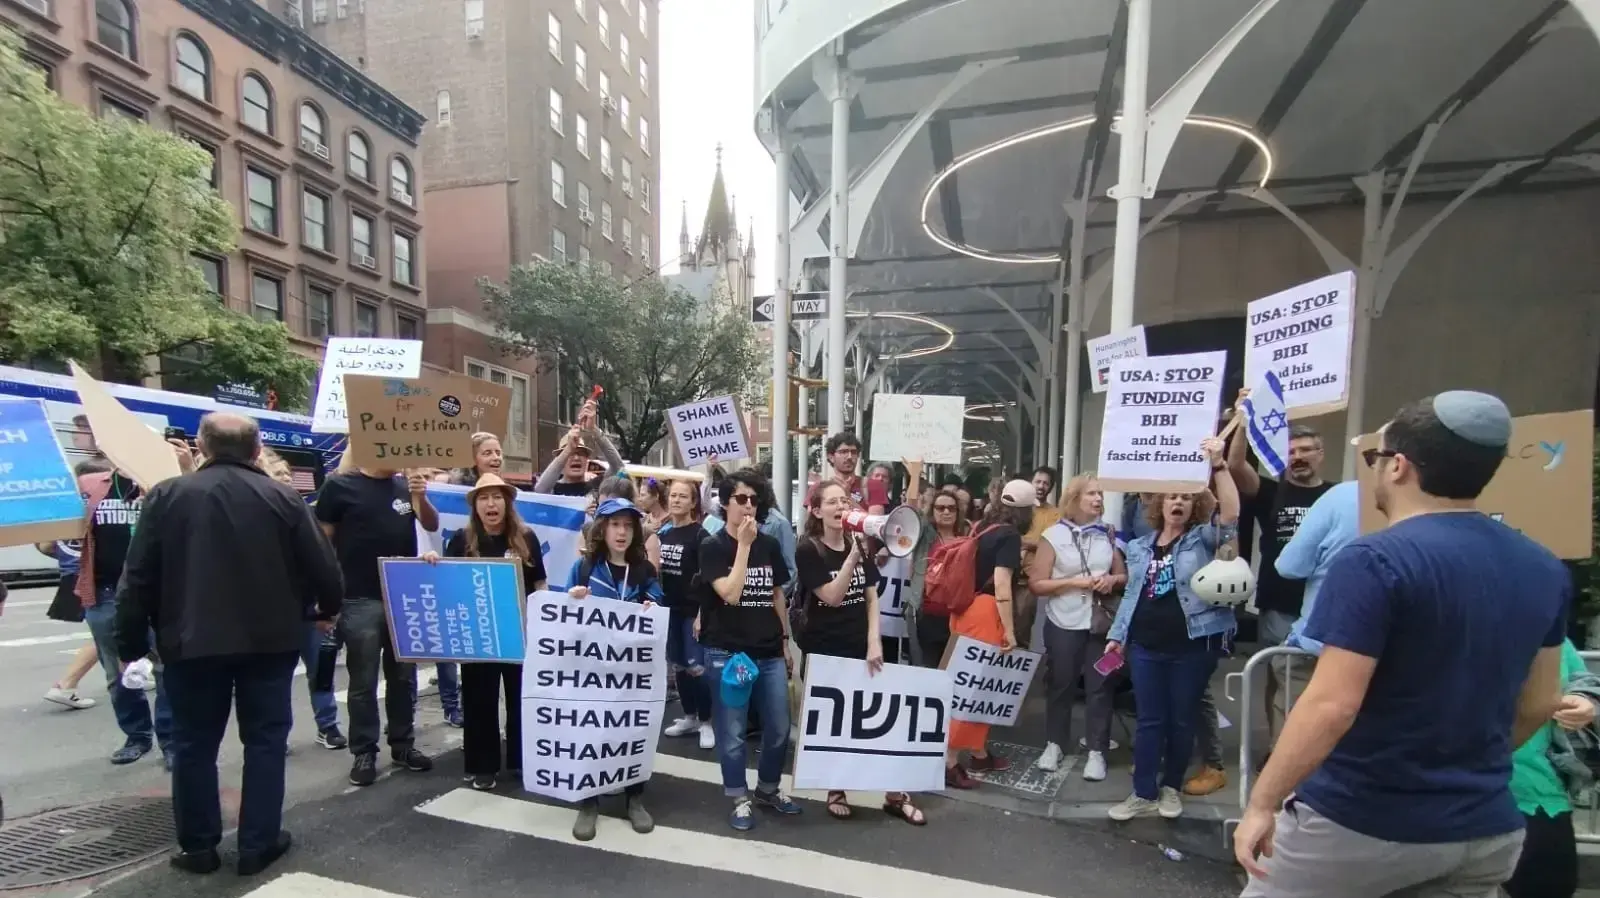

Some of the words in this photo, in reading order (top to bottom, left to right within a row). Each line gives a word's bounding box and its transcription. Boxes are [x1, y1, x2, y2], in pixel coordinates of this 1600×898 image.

[796, 301, 820, 313] WAY
[1250, 307, 1287, 326] USA:
[1291, 290, 1338, 315] STOP
[1253, 314, 1333, 346] FUNDING
[1272, 342, 1309, 361] BIBI
[1120, 370, 1160, 383] USA:
[1164, 367, 1214, 381] STOP
[1292, 362, 1313, 375] his
[1289, 372, 1337, 391] friends
[1121, 391, 1205, 405] FUNDING
[360, 412, 470, 432] Palestinian
[677, 402, 729, 422] SHAME
[1140, 414, 1178, 427] BIBI
[682, 422, 735, 441] SHAME
[1131, 435, 1156, 446] and
[1160, 435, 1181, 446] his
[373, 442, 454, 458] Justice
[688, 441, 740, 459] SHAME
[1107, 450, 1151, 462] fascist
[1154, 450, 1204, 463] friends
[419, 584, 443, 653] MARCH
[445, 608, 460, 635] THE
[458, 603, 470, 620] OF
[472, 568, 495, 655] AUTOCRACY
[540, 603, 654, 635] SHAME
[402, 593, 424, 653] DON'T
[451, 640, 462, 655] TO
[460, 624, 474, 655] BEAT
[538, 637, 653, 663] SHAME
[964, 646, 1033, 673] SHAME
[537, 669, 652, 690] SHAME
[954, 671, 1024, 696] SHAME
[805, 686, 946, 743] בושה
[951, 694, 1014, 718] SHAME
[536, 706, 650, 728] SHAME
[536, 739, 646, 761] SHAME
[536, 763, 642, 791] SHAME
